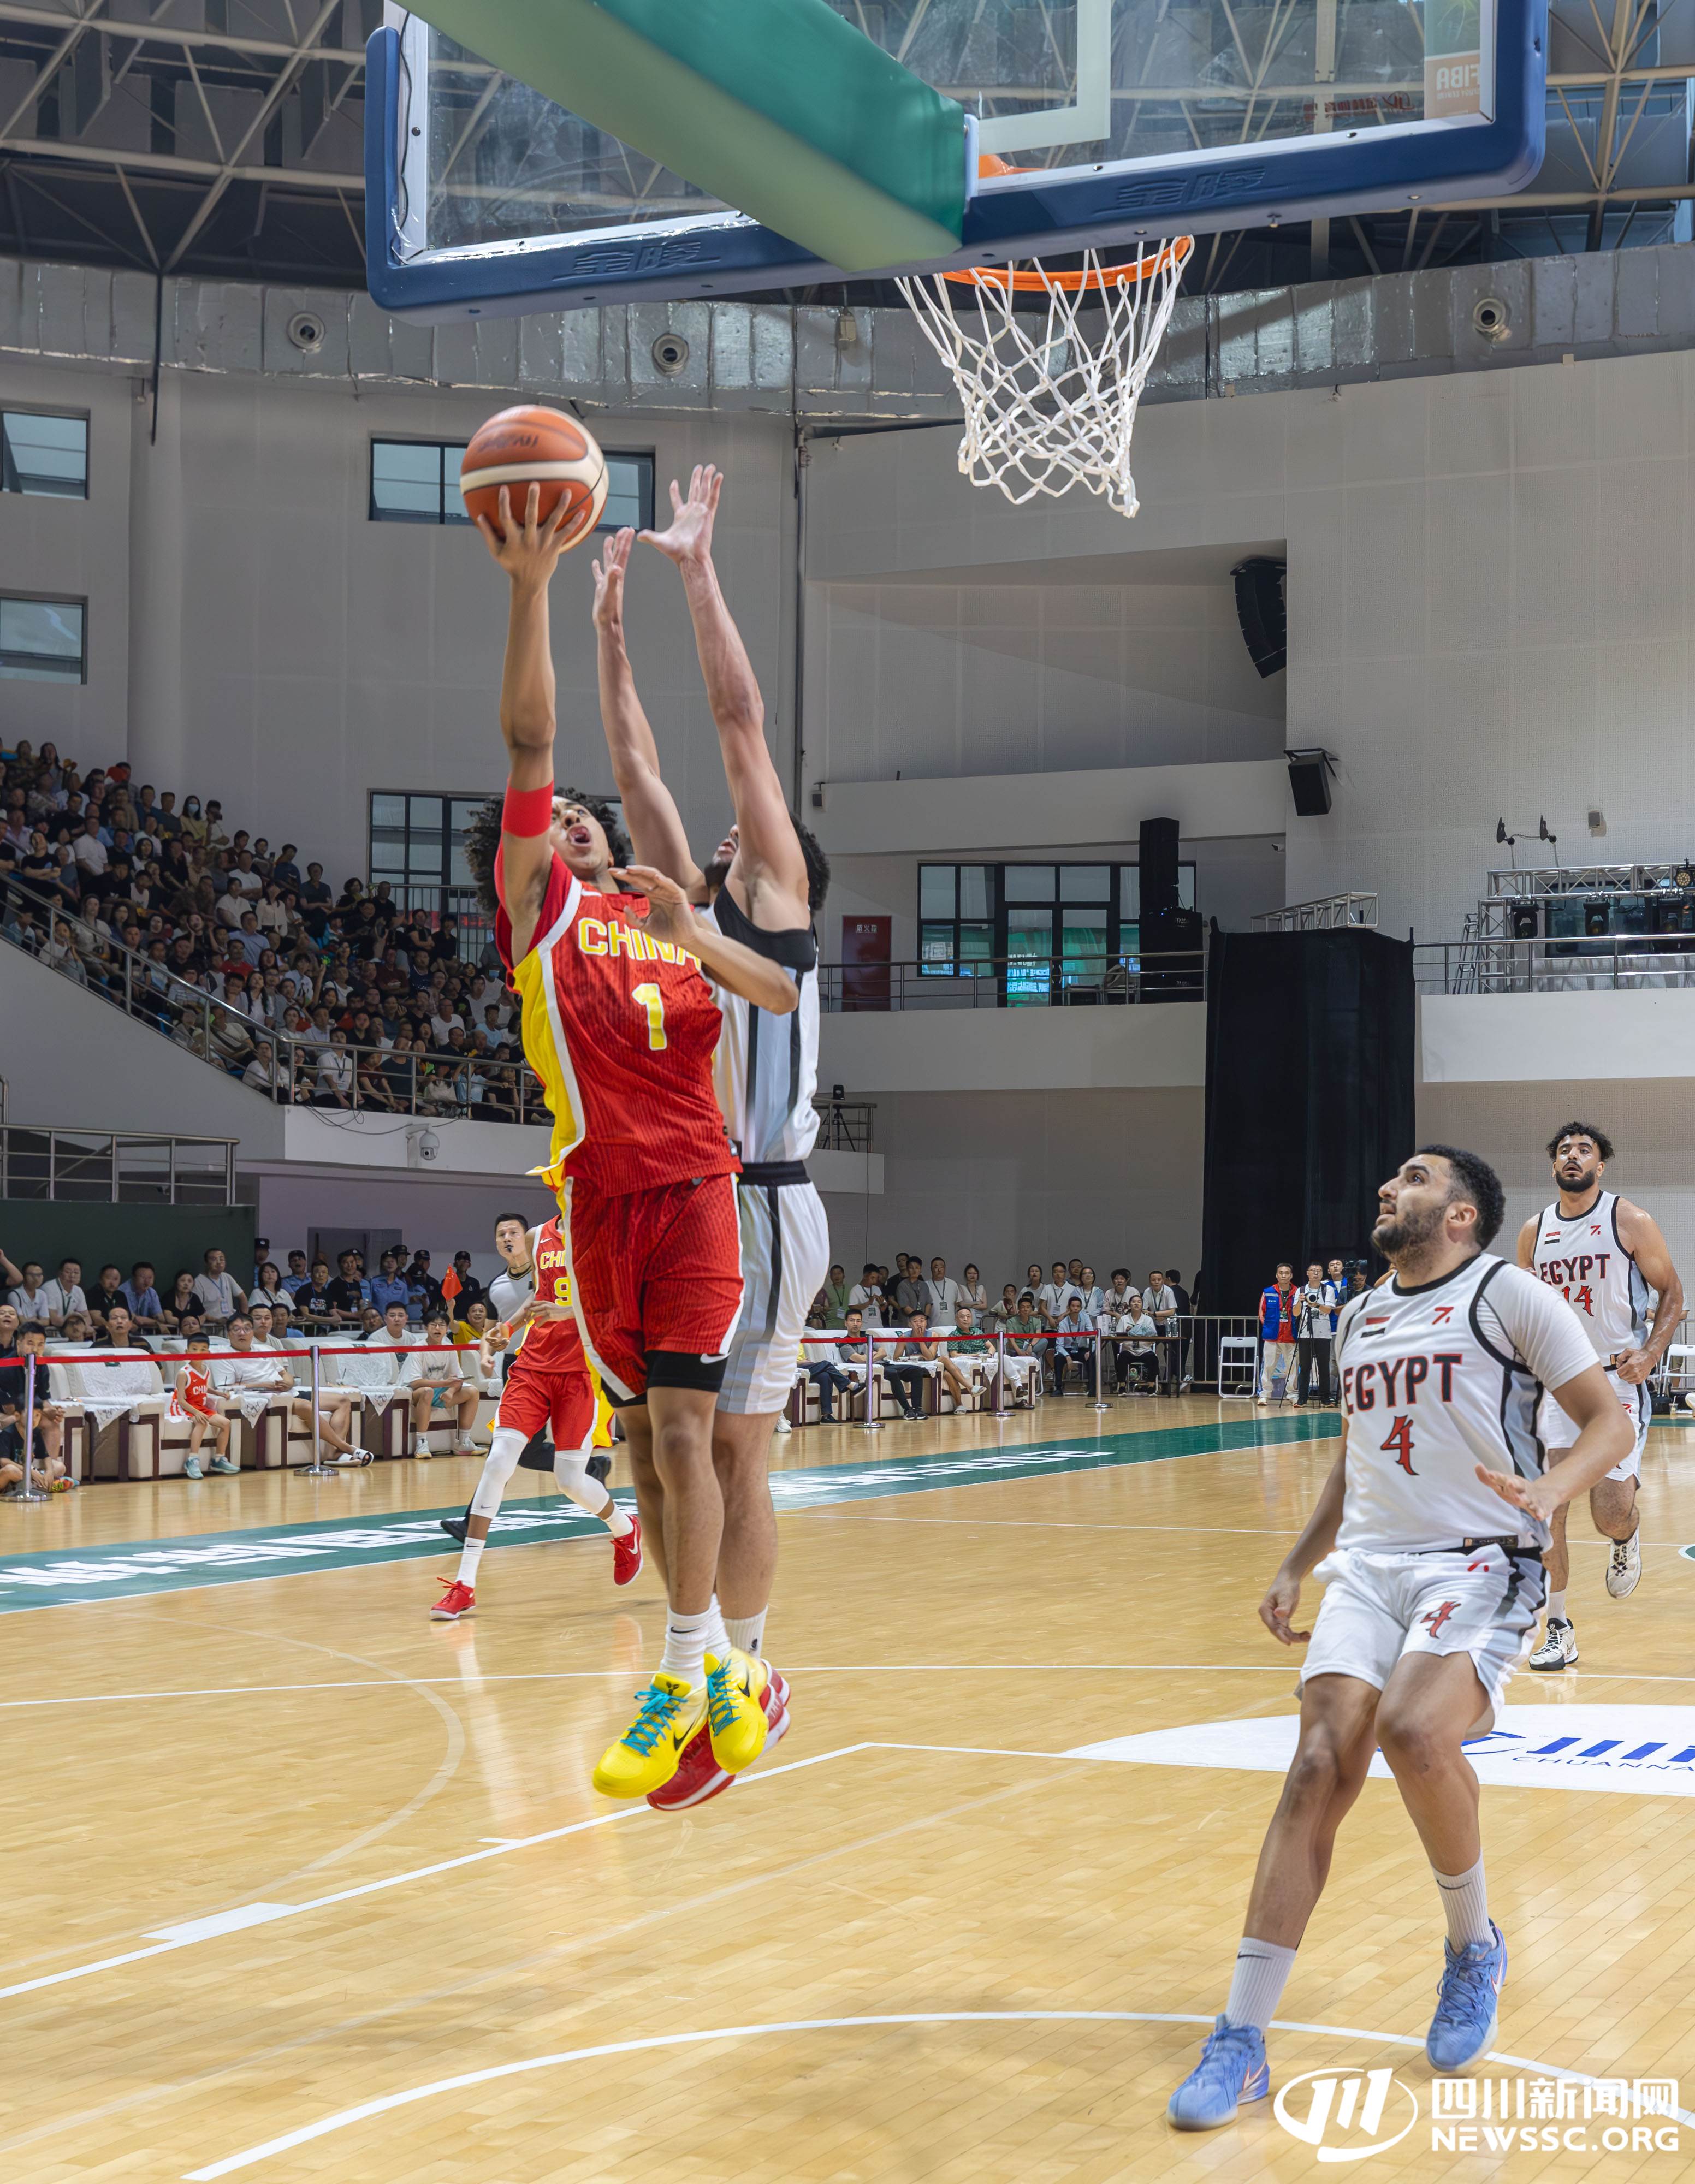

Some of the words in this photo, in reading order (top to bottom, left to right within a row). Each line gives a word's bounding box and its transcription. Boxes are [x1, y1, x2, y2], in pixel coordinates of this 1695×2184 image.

[632, 983, 667, 1051] 1
[540, 1250, 566, 1269] CHI
[1540, 1254, 1610, 1285] EGYPT
[554, 1277, 572, 1307] 9
[1562, 1285, 1595, 1317] 14
[1343, 1354, 1462, 1415] EGYPT
[1380, 1415, 1420, 1476] 4
[1420, 1600, 1461, 1639] 4
